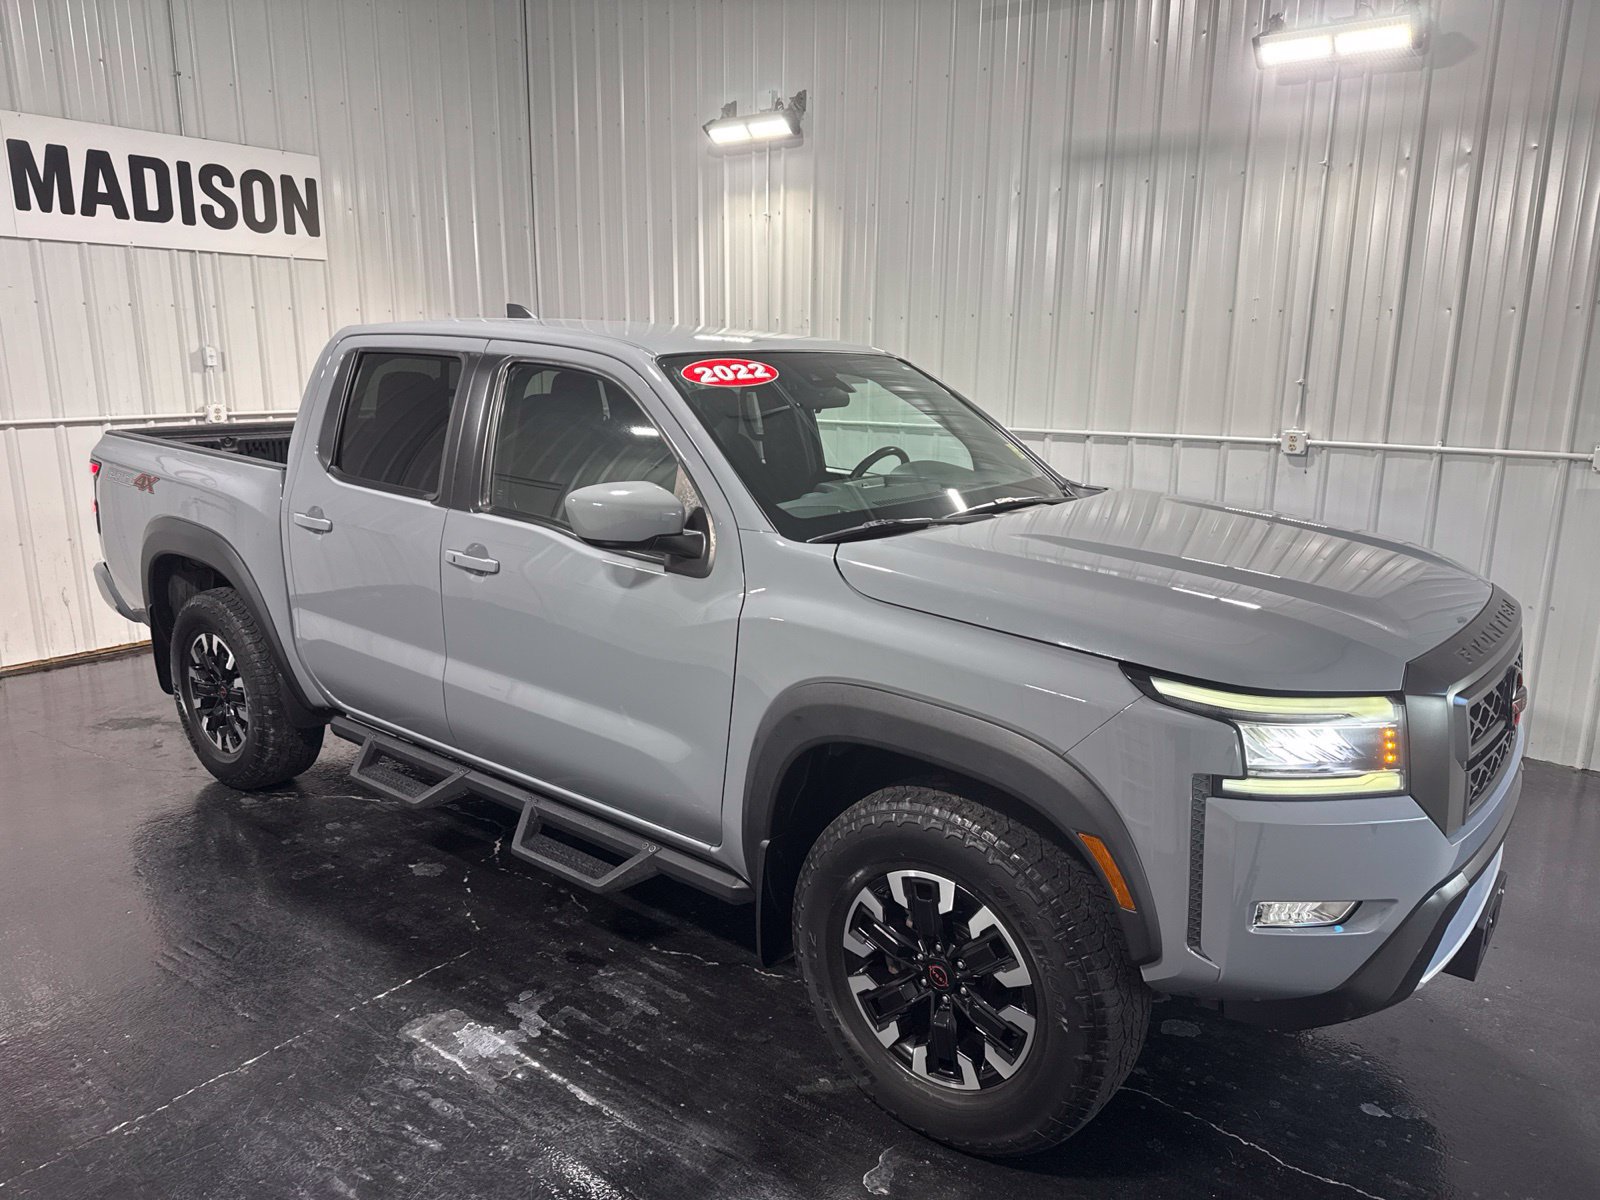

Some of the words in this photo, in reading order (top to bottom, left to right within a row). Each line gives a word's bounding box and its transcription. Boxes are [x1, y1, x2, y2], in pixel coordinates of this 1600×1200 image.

[6, 138, 321, 238] MADISON
[693, 363, 772, 383] 2022
[1455, 598, 1516, 664] FRONTIER
